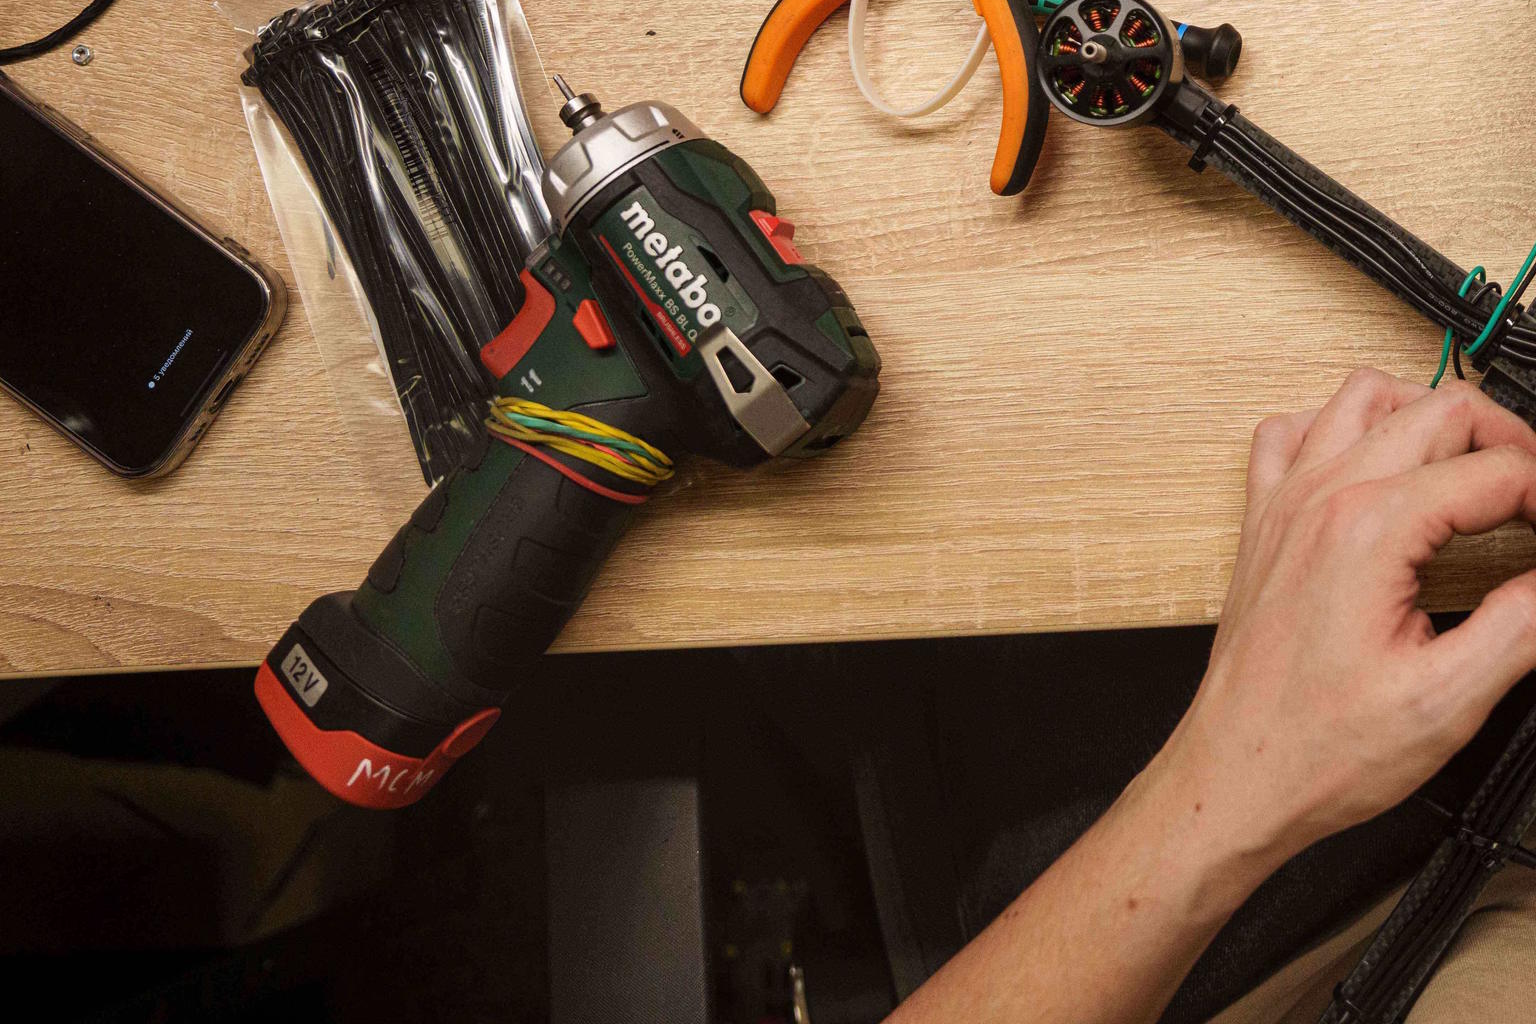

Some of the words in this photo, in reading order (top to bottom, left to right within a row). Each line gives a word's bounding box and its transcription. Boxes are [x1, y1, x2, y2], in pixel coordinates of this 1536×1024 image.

[619, 200, 722, 327] metabo
[622, 241, 668, 301] PowerMaxx
[664, 298, 681, 316] BS
[675, 314, 690, 331] BL
[158, 328, 194, 376] уведомлений
[656, 311, 687, 351] BRUSHLESS
[288, 655, 320, 693] 12V
[346, 757, 435, 795] MCM
